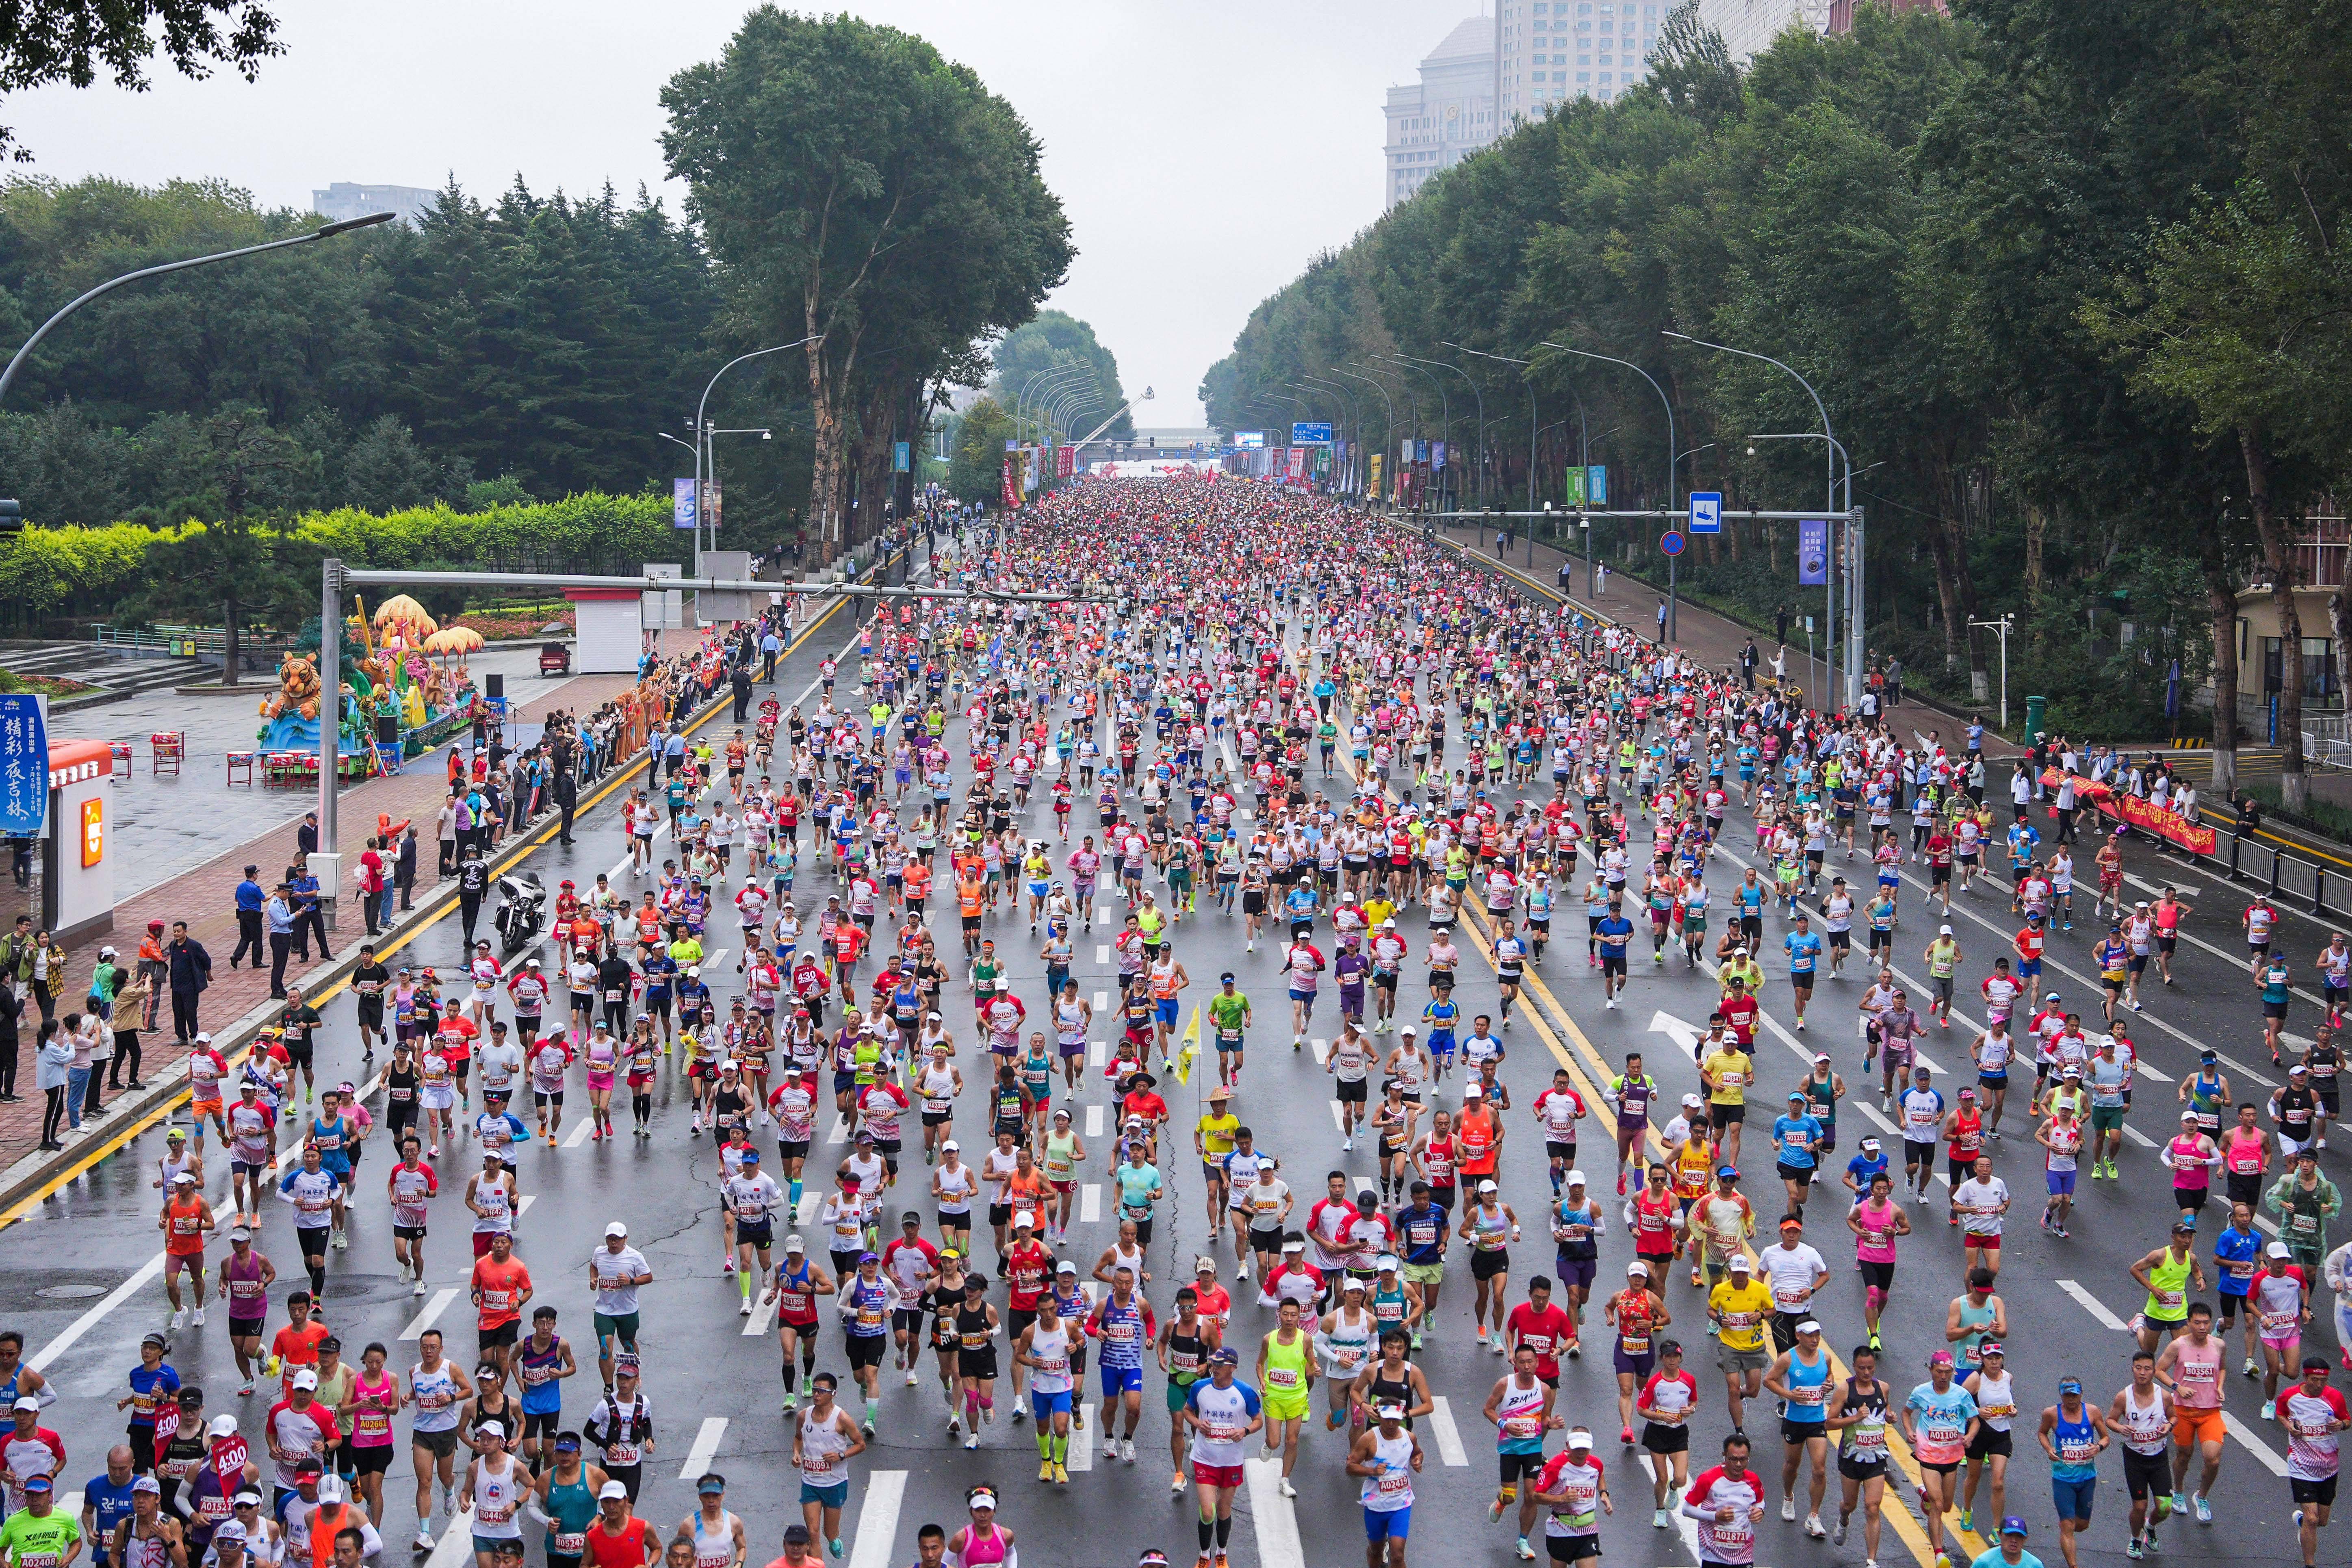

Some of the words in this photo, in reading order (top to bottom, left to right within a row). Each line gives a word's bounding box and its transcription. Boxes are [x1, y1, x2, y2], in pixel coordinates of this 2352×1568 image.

[798, 971, 816, 982] 4:30
[1388, 1136, 1406, 1145] B05241
[1685, 1172, 1704, 1181] A01518
[1412, 1232, 1435, 1240] A00903
[900, 1290, 919, 1299] 02830
[1778, 1293, 1801, 1301] A0267
[2272, 1314, 2293, 1324] 01165
[1524, 1338, 1549, 1348] A02446
[1336, 1349, 1360, 1359] A02816
[1173, 1356, 1197, 1365] A01076
[2186, 1366, 2213, 1375] B03561
[525, 1371, 548, 1380] A02065
[1270, 1373, 1296, 1381] A02395
[157, 1414, 179, 1432] 4:00
[1857, 1435, 1884, 1443] A02455
[1930, 1431, 1957, 1439] A01106
[2133, 1433, 2158, 1442] A0238
[218, 1447, 247, 1468] 4:00
[169, 1464, 188, 1472] B047
[1381, 1478, 1407, 1490] A02419
[201, 1503, 231, 1512] A01521
[1715, 1532, 1746, 1540] A01871
[556, 1538, 585, 1547] B05242
[22, 1558, 55, 1567] A02408
[701, 1556, 730, 1567] B04285
